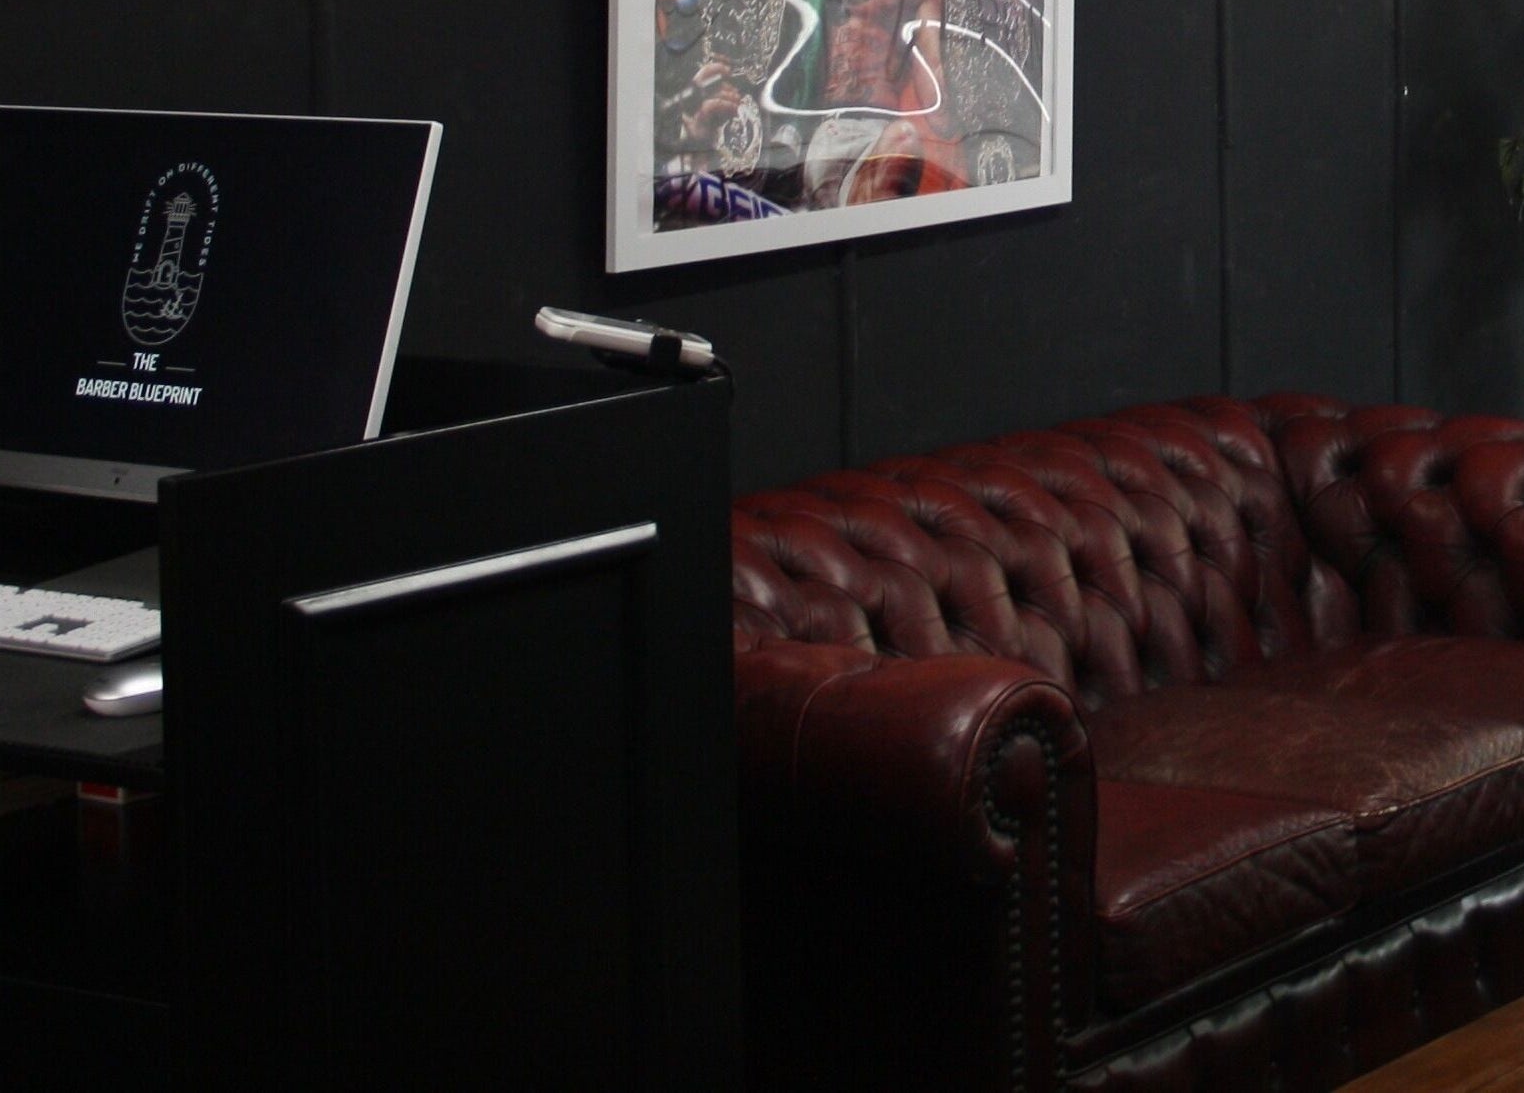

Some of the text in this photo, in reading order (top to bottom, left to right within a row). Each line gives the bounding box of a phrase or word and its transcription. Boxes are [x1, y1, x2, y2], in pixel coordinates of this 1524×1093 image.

[132, 351, 160, 372] THE
[75, 377, 203, 406] BARBER BLUEPRINT
